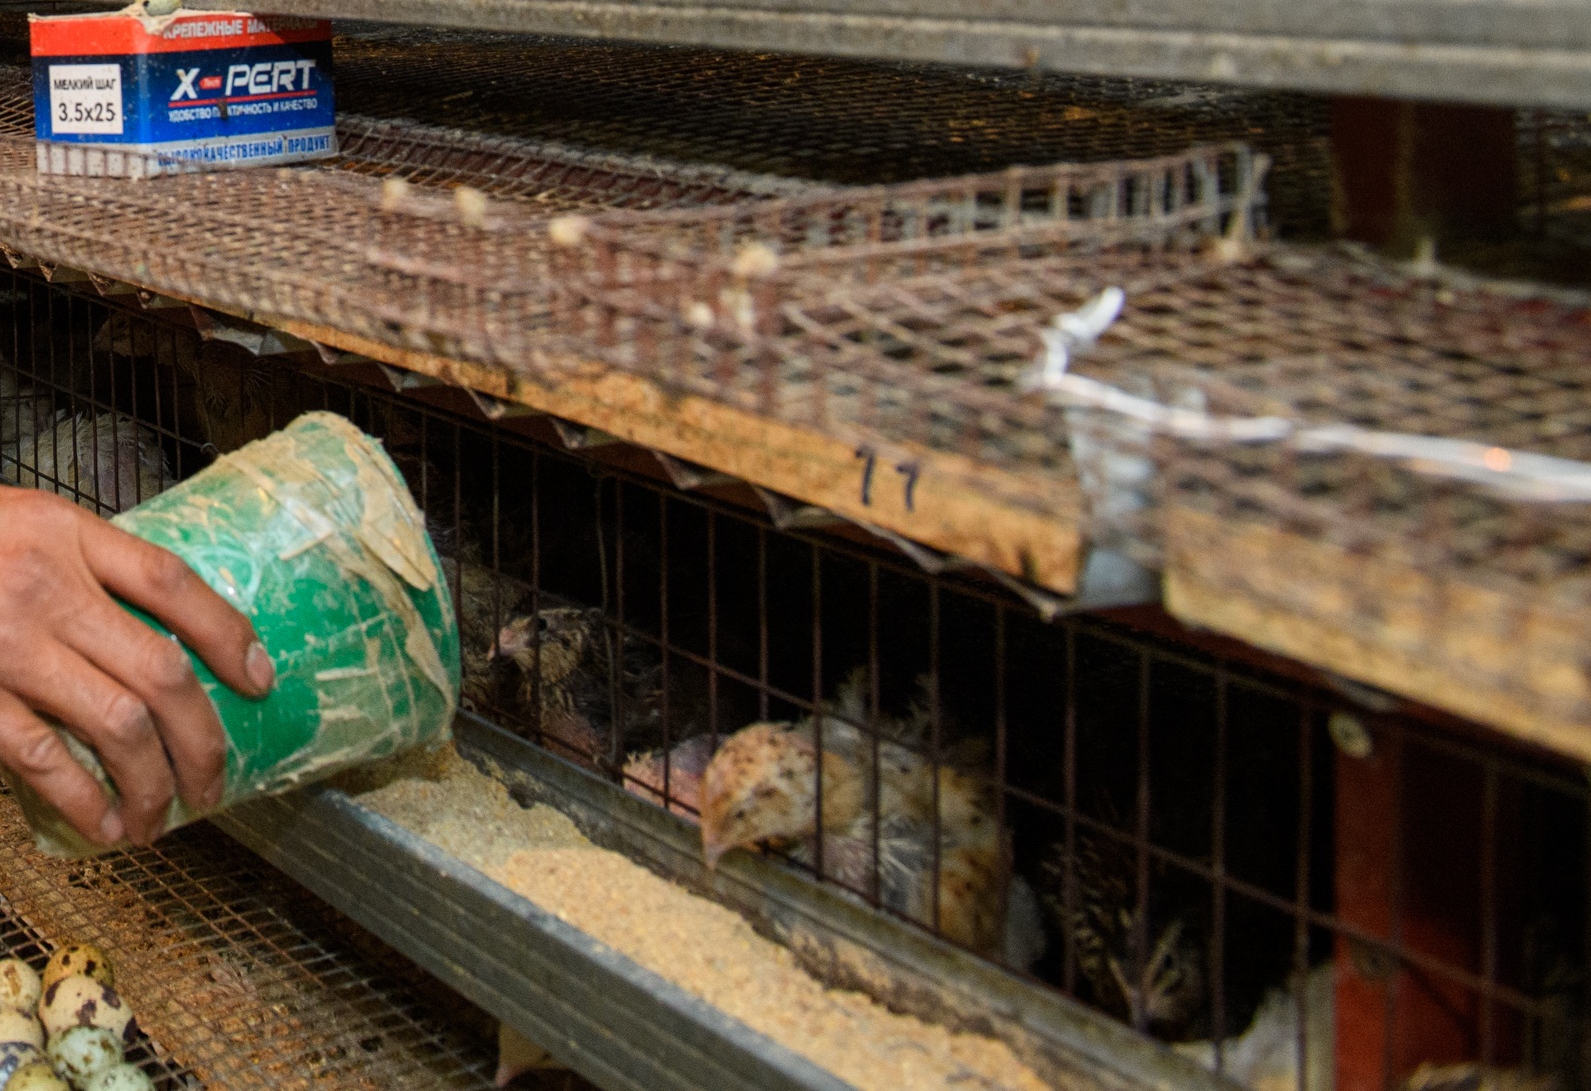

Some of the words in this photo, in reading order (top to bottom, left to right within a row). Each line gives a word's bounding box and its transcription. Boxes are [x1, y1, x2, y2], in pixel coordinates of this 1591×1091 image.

[54, 76, 93, 90] МЕЛКИЙ
[95, 79, 116, 90] ШАГ
[273, 101, 279, 112] И
[288, 134, 330, 153] ПРОДУКТ
